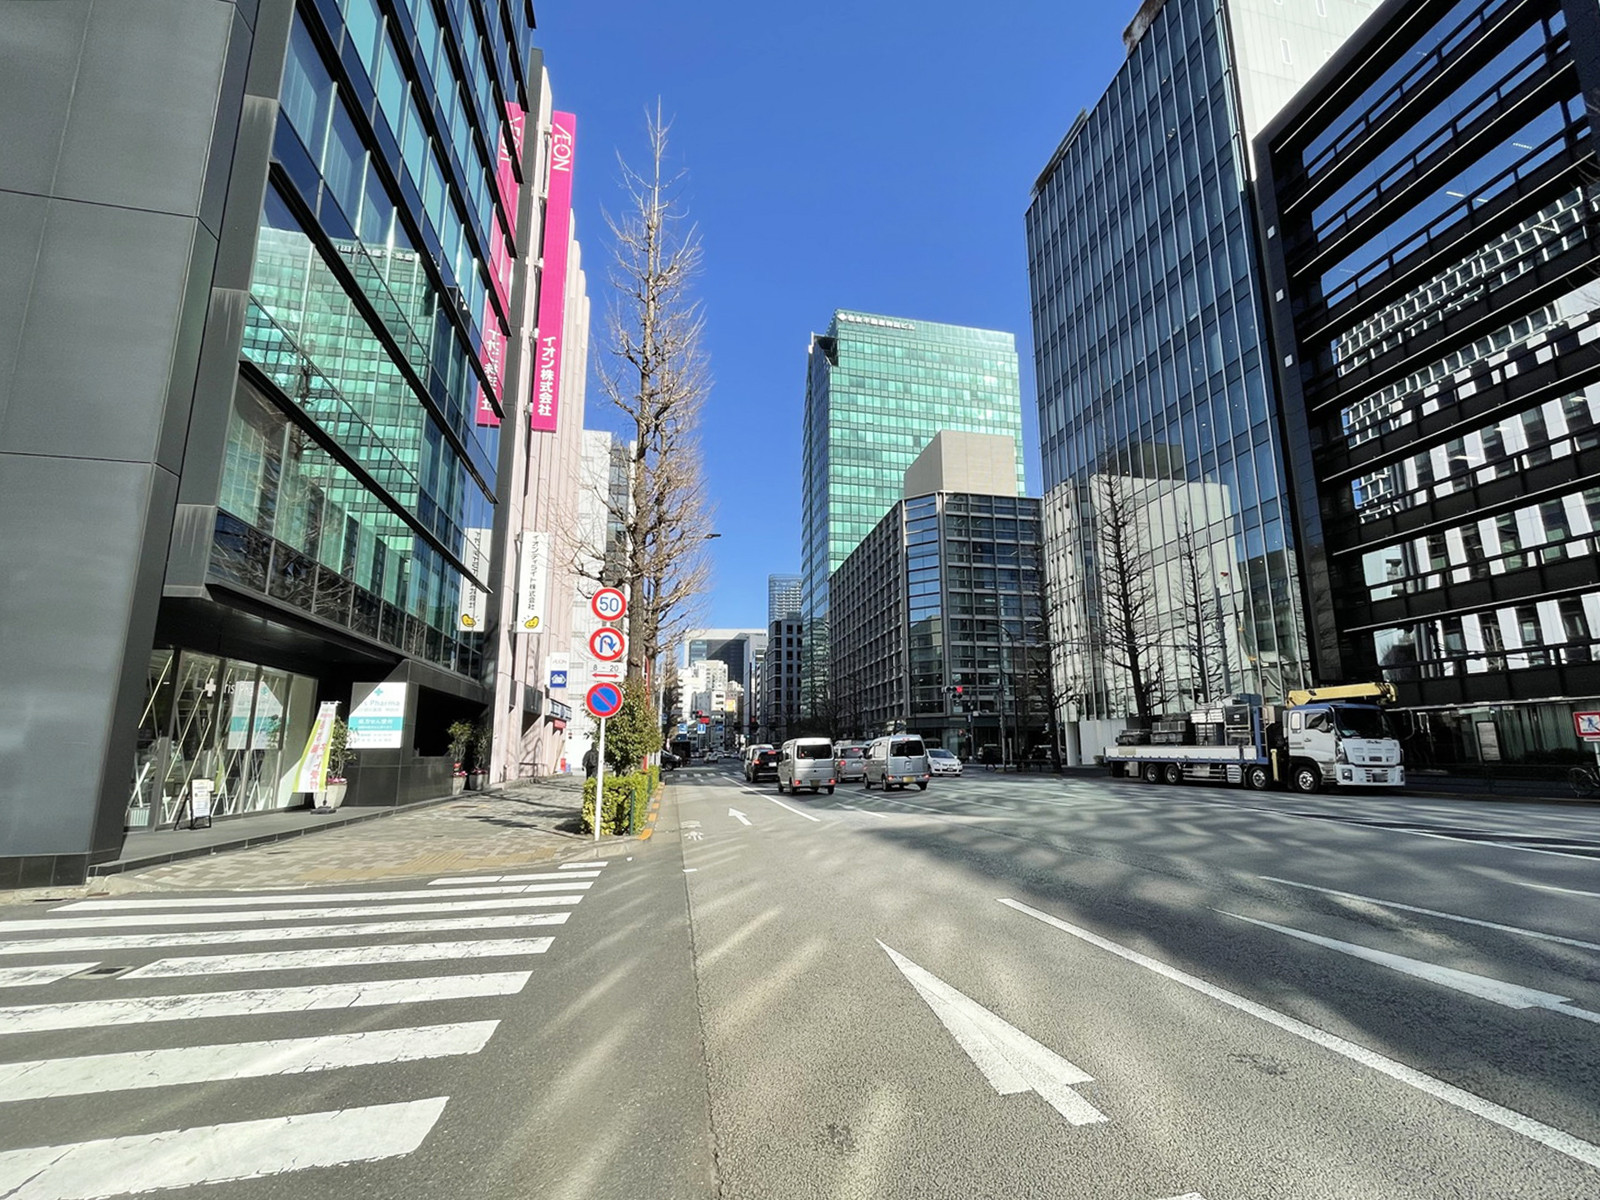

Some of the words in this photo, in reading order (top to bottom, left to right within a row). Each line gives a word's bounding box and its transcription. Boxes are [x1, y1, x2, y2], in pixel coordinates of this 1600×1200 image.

[537, 336, 557, 417] イオン株式会社
[599, 596, 619, 613] 50
[223, 680, 236, 695] ris
